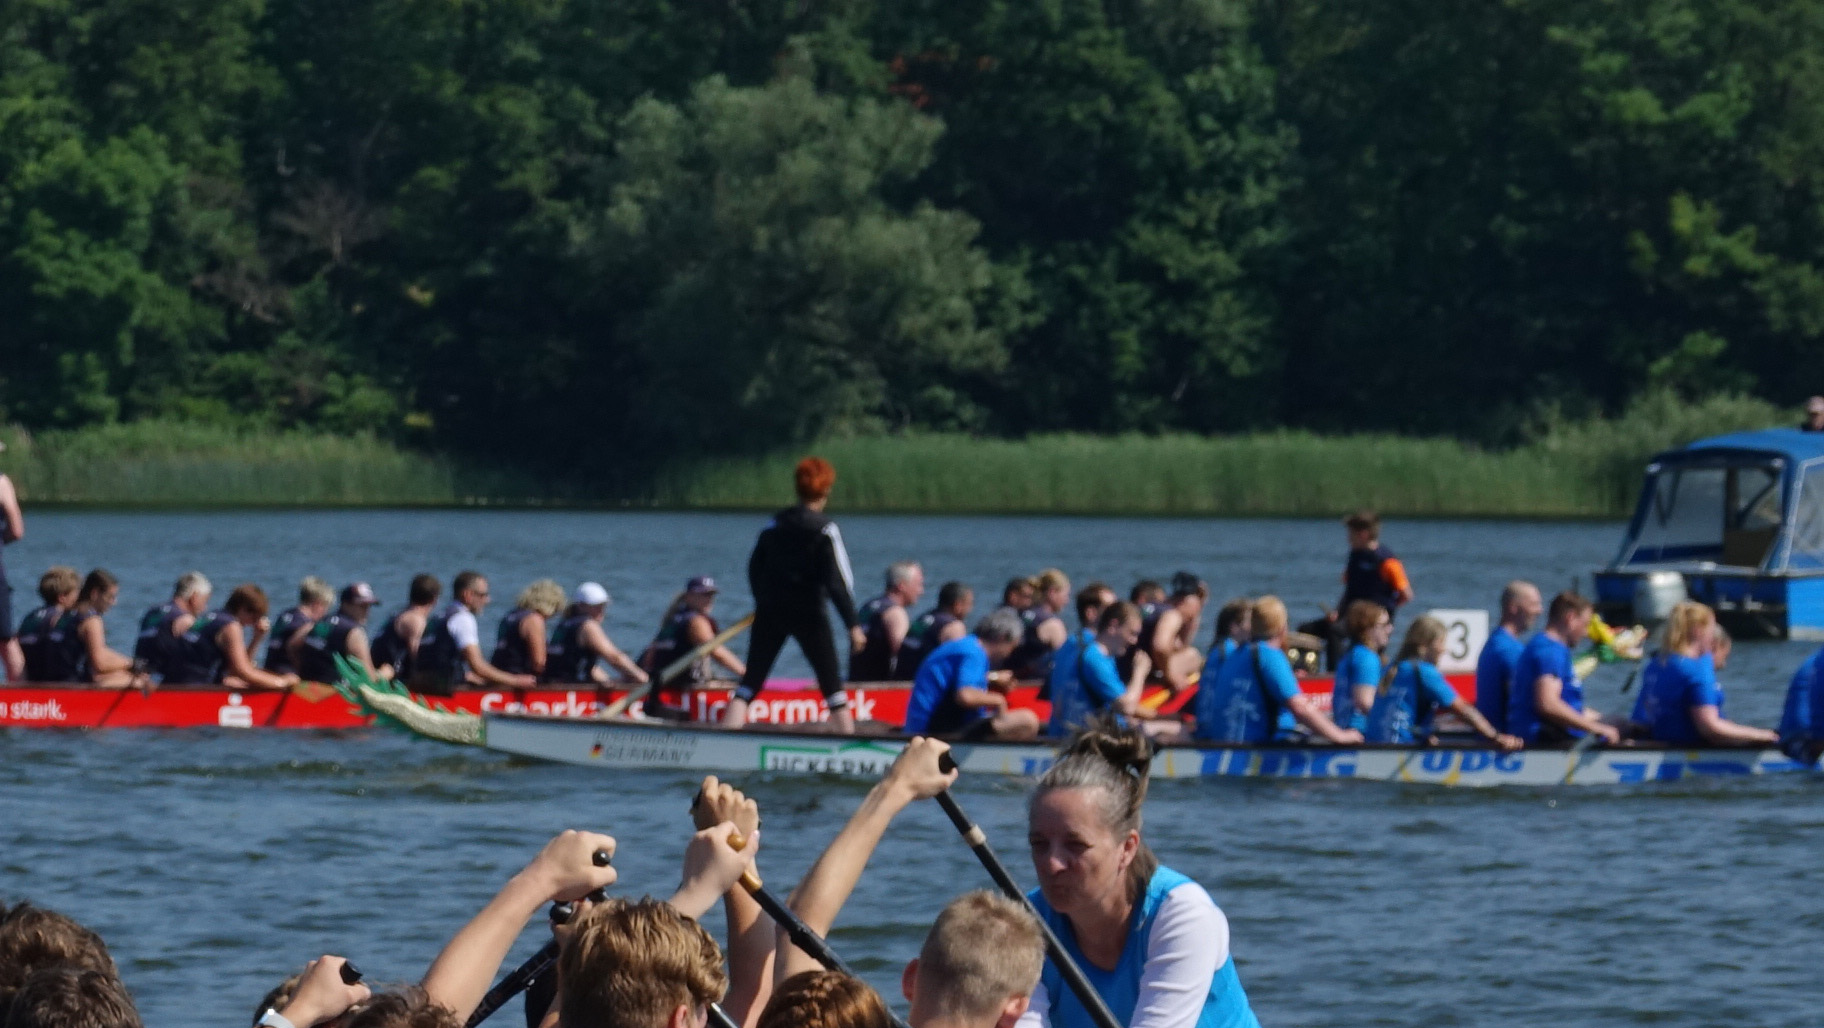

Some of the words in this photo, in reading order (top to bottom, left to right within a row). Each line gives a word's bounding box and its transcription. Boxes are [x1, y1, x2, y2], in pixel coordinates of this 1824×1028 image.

[1452, 621, 1472, 661] 3
[10, 698, 68, 721] stark.
[1420, 751, 1528, 775] UDG
